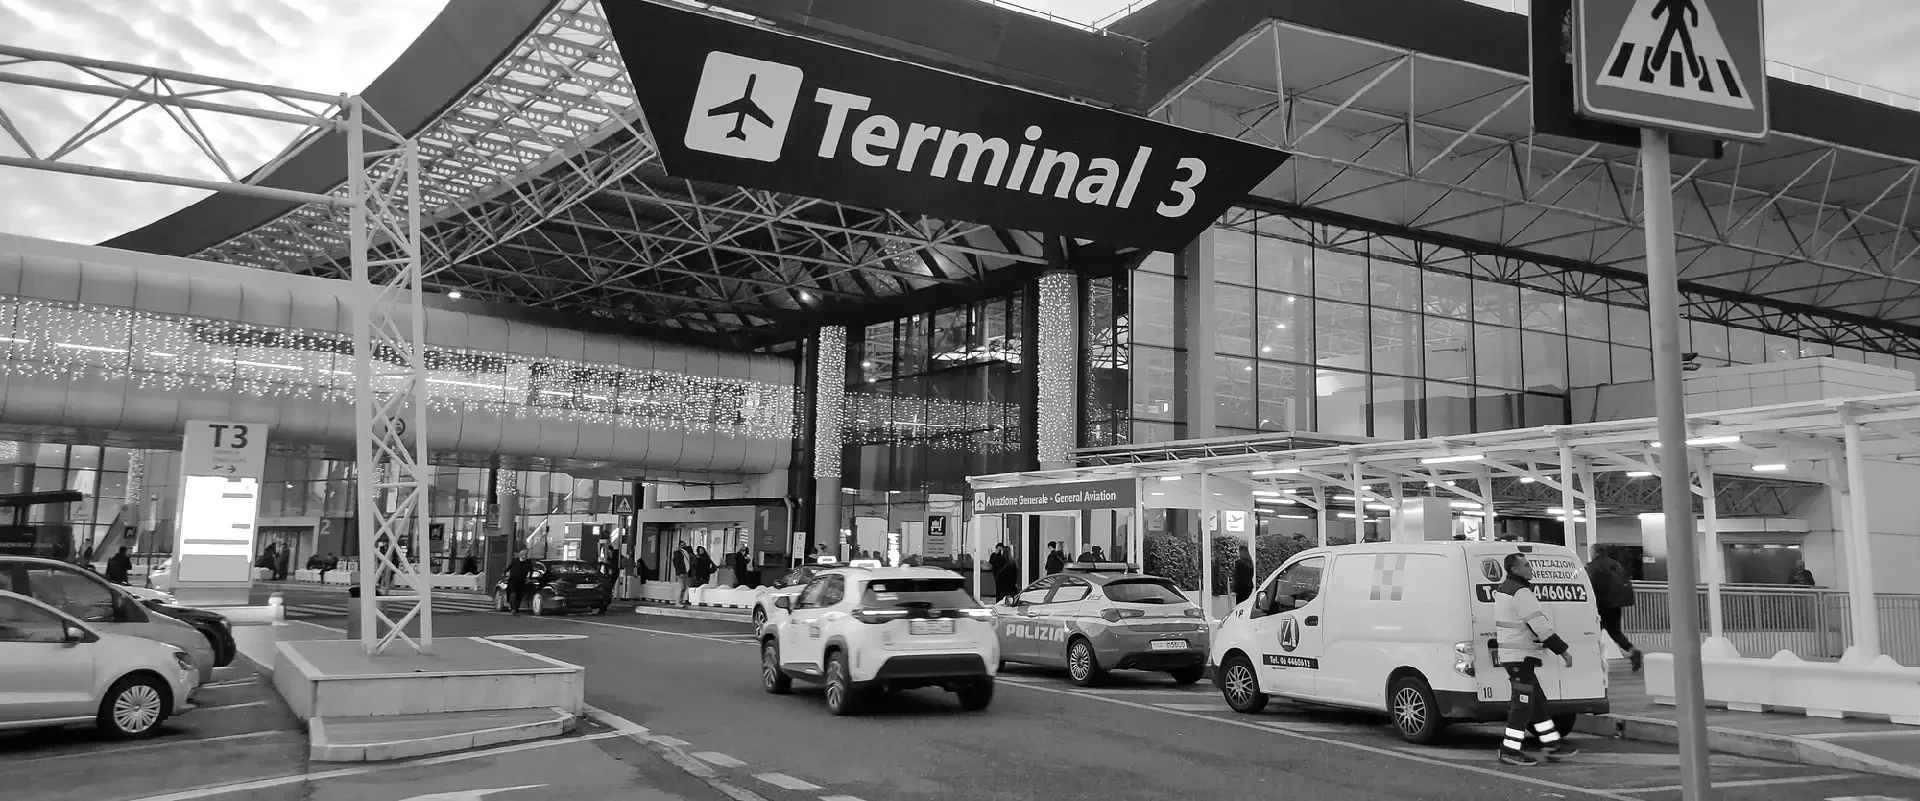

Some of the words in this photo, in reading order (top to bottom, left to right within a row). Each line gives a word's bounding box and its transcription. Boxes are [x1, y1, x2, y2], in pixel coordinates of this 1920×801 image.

[814, 87, 1152, 209] Terminal
[1156, 157, 1207, 218] 3
[208, 424, 248, 448] T3
[986, 496, 1018, 507] Aviazione
[1020, 494, 1048, 506] Generale
[1055, 491, 1082, 503] General
[1084, 489, 1117, 502] Aviation
[320, 519, 331, 535] 2
[760, 509, 769, 530] 1
[1006, 624, 1065, 642] POLIZIA
[1269, 656, 1279, 664] Tel.
[1280, 656, 1287, 665] 06
[1287, 657, 1311, 668] 4460612
